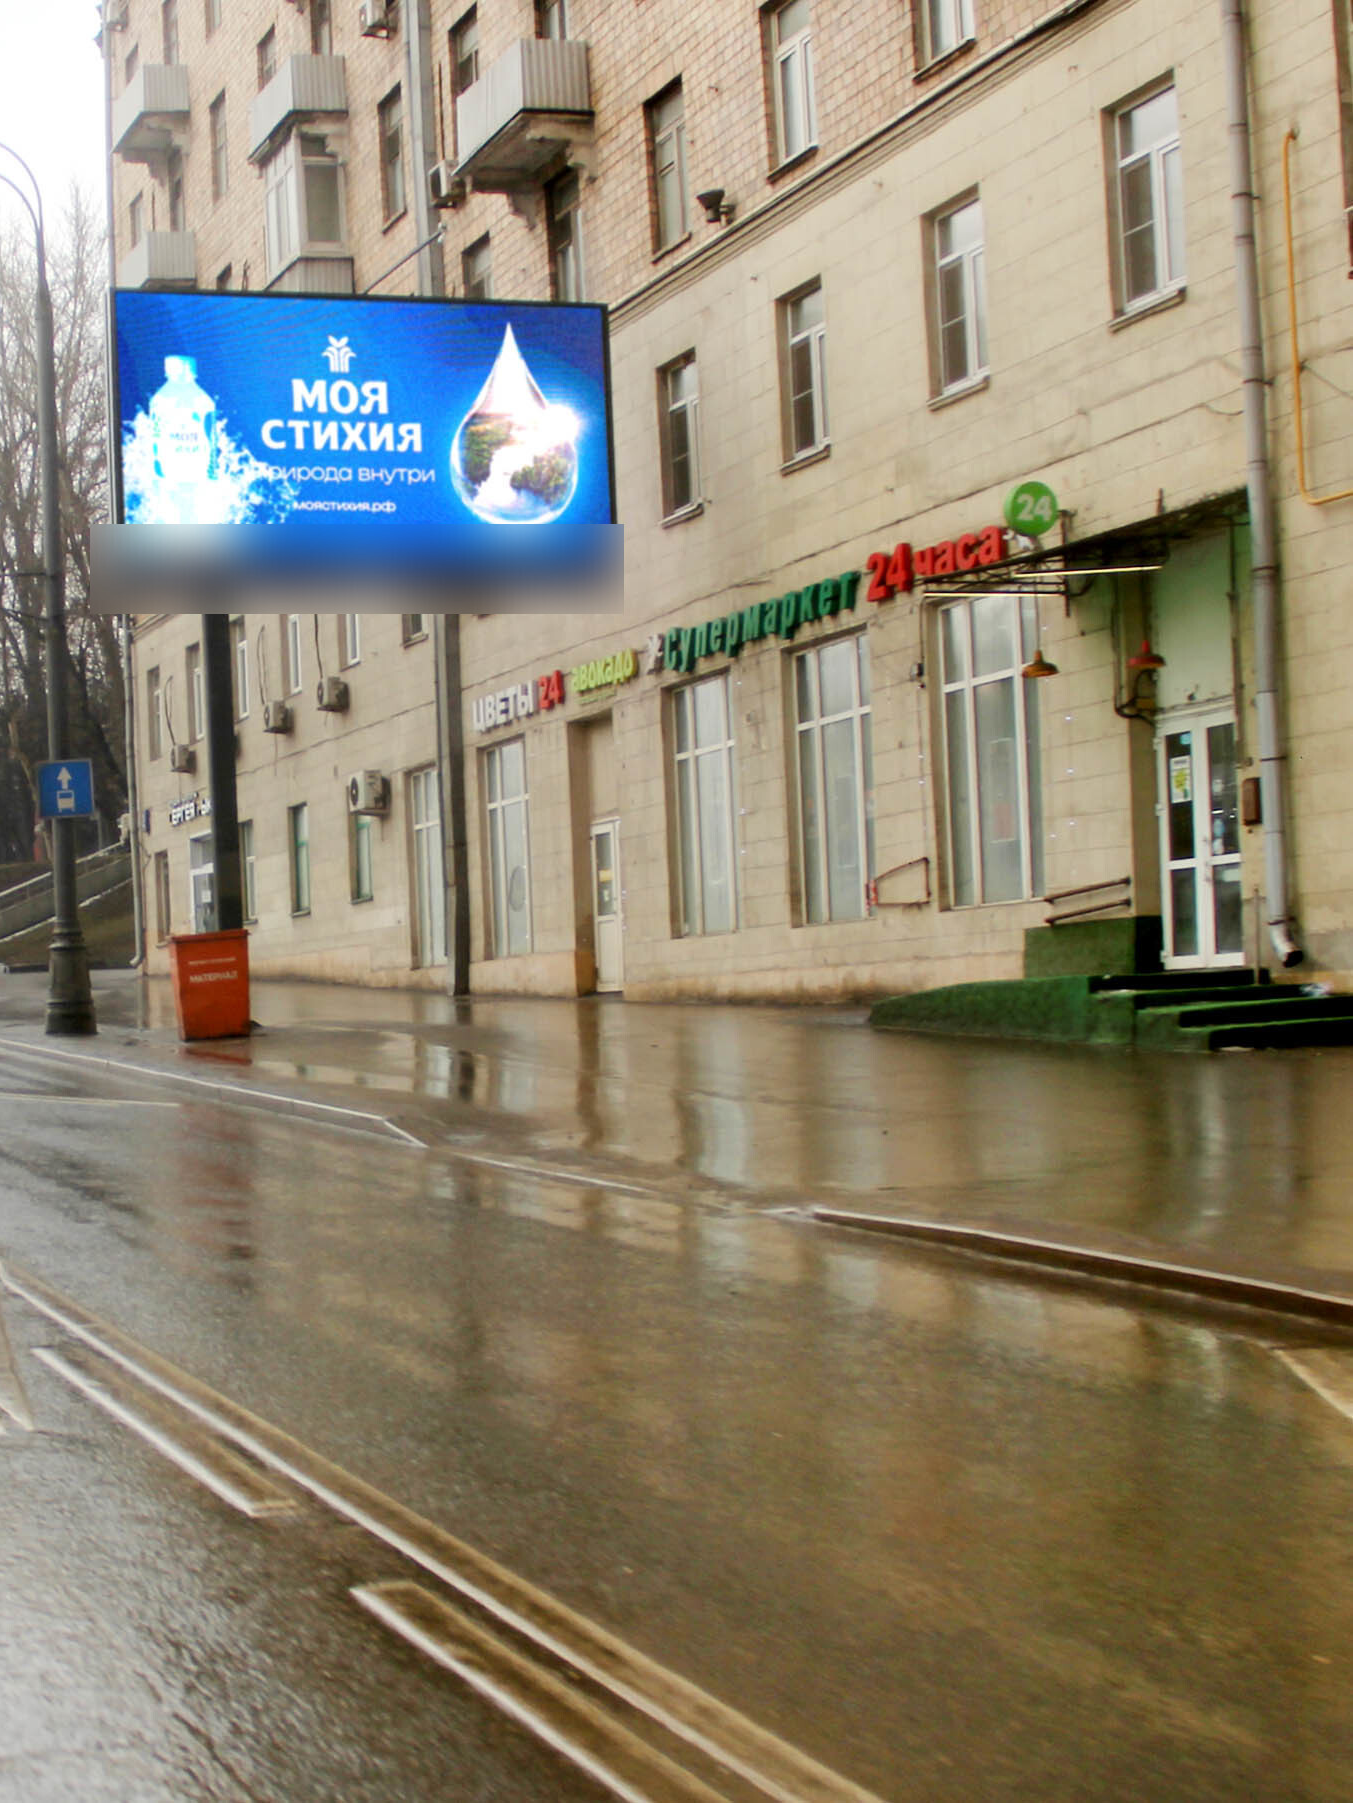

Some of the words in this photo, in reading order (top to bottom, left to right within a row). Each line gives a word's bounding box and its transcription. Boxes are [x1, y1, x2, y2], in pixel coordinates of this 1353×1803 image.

[291, 378, 389, 415] МОЯ
[260, 419, 423, 452] СТИХИЯ
[357, 467, 436, 485] внутри
[295, 500, 396, 513] моястихия.рф
[1017, 493, 1053, 521] 24
[866, 542, 914, 602] 24
[913, 525, 1007, 577] часа
[571, 648, 638, 693] авокадо
[472, 679, 538, 733] ЦВЕТЫ
[538, 669, 564, 711] 24
